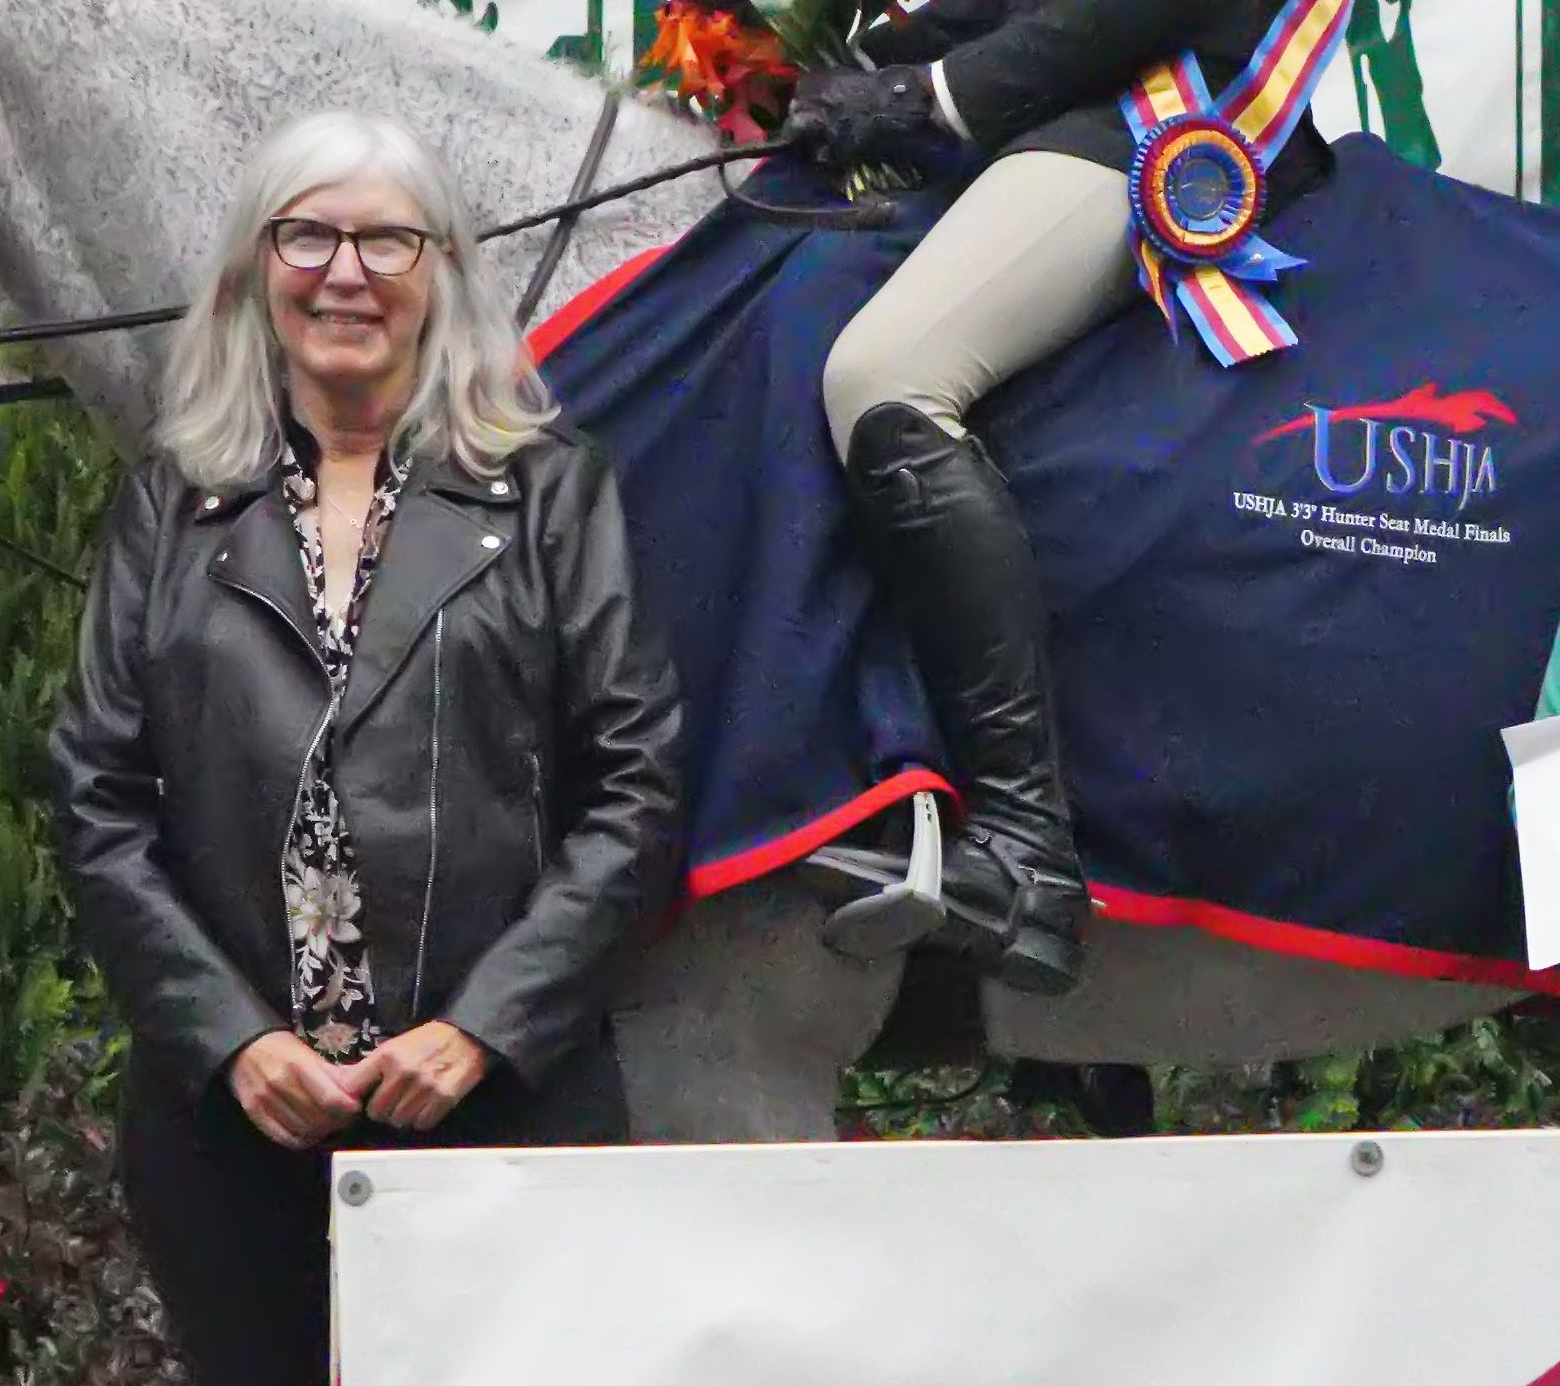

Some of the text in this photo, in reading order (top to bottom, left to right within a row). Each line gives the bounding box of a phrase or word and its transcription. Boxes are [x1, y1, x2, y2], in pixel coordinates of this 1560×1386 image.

[1303, 401, 1497, 511] USHJA
[1233, 492, 1287, 519] USHJA
[1321, 505, 1376, 529] Hunter
[1378, 513, 1410, 532] Seat
[1413, 518, 1461, 540] Medal
[1463, 524, 1511, 543] Finals
[1300, 529, 1437, 565] Overall Champion
